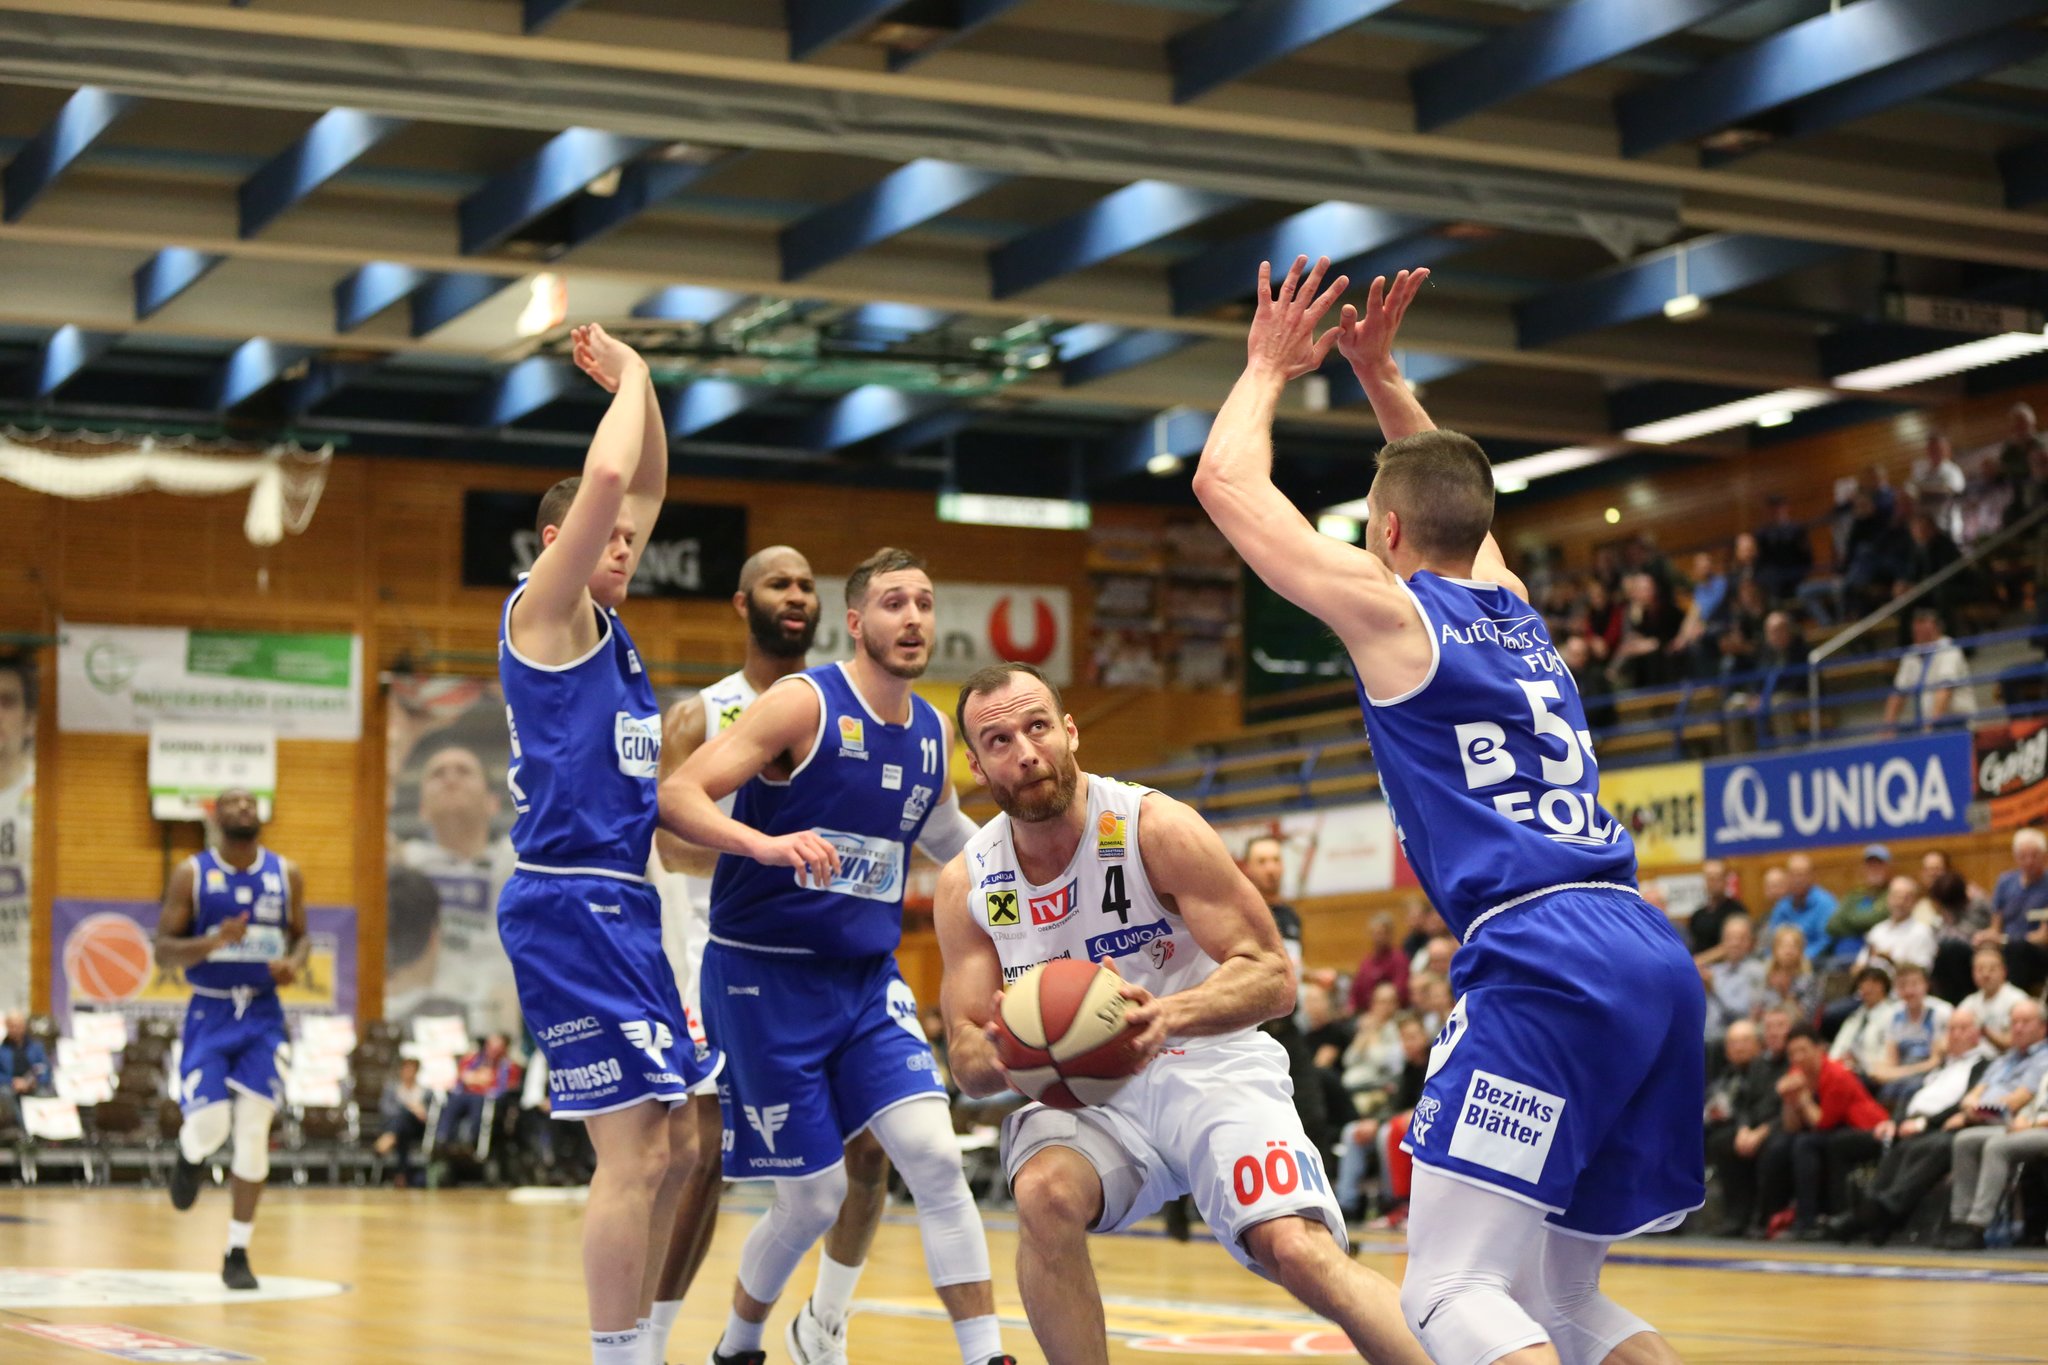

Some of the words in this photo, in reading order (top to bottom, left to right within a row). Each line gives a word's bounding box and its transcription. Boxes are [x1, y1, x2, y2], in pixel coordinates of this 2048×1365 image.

[920, 737, 937, 775] 11
[1788, 754, 1955, 837] UNIQA
[1102, 864, 1131, 924] 4
[1116, 926, 1166, 951] UNIQA
[1472, 1077, 1555, 1123] Bezirks
[1464, 1103, 1543, 1148] Blätter
[1232, 1141, 1325, 1206] OÖN
